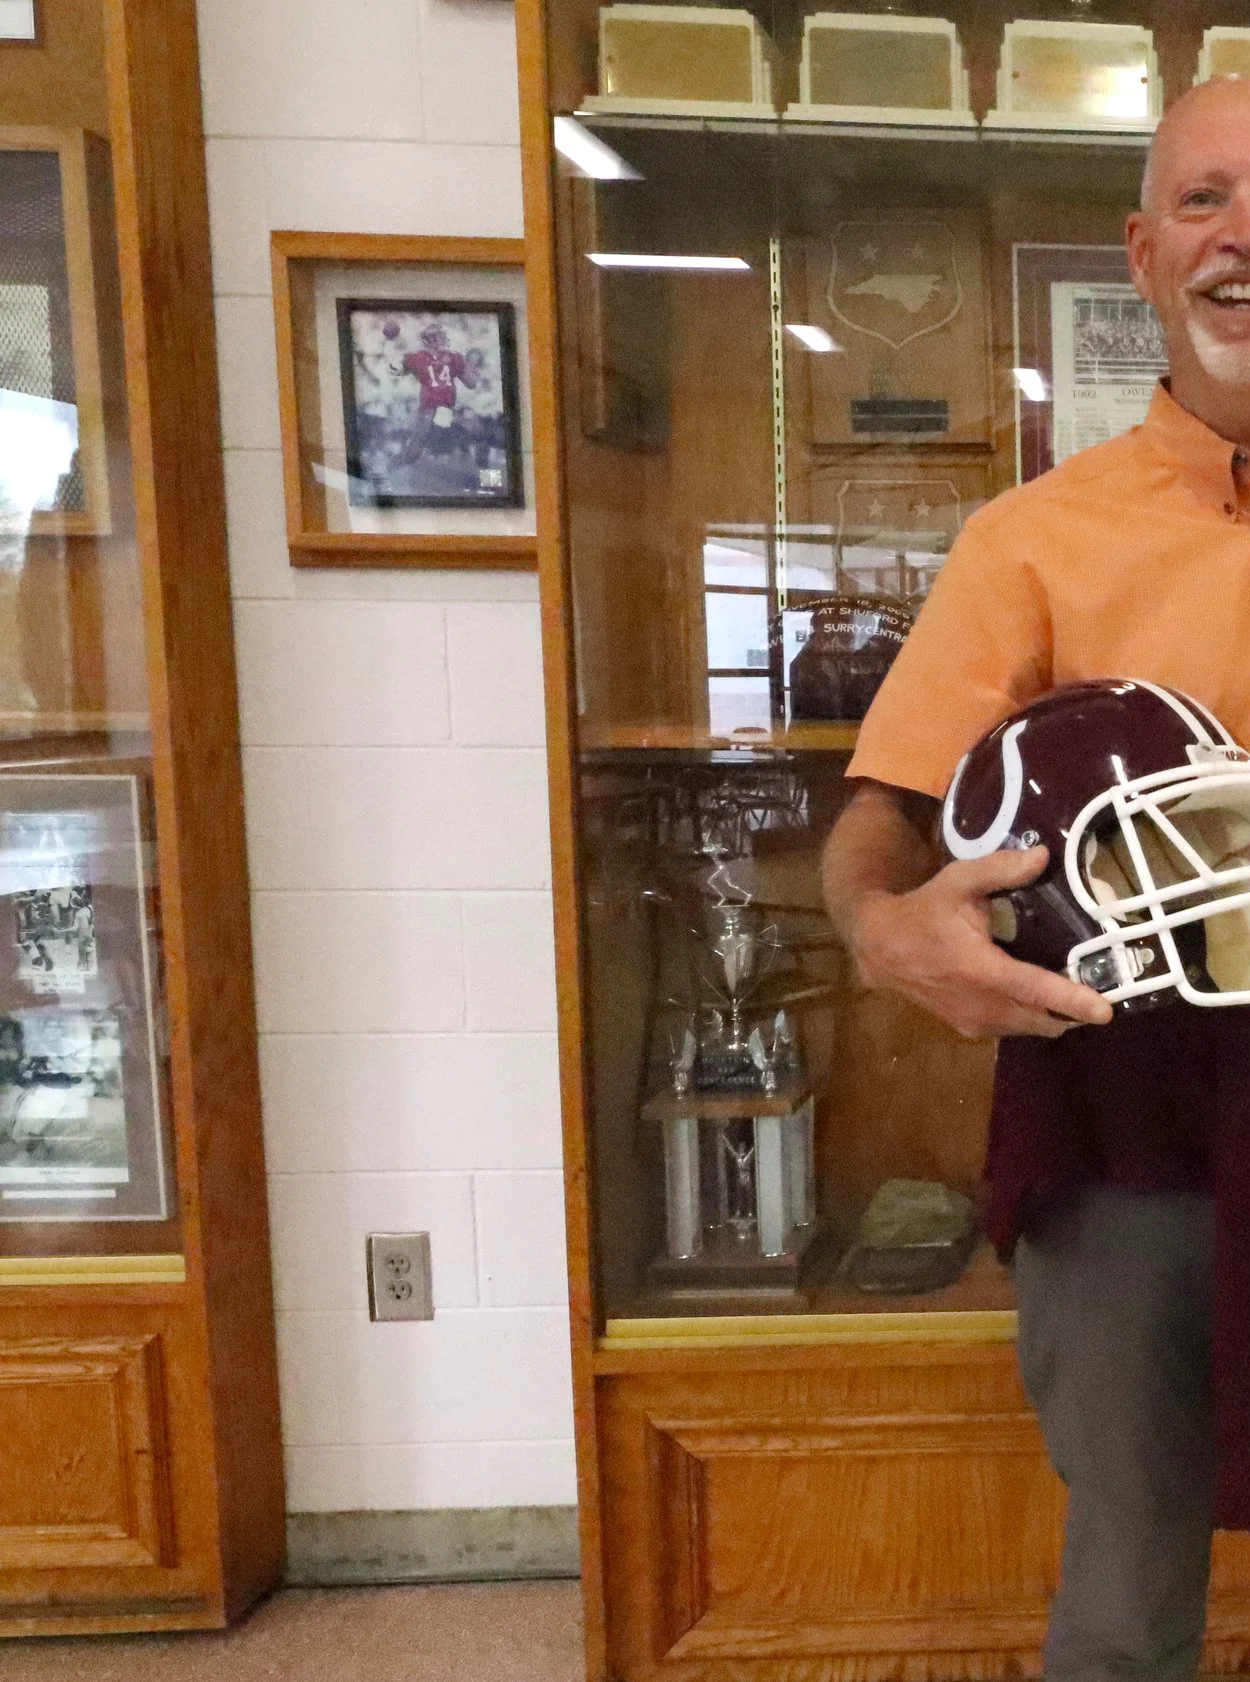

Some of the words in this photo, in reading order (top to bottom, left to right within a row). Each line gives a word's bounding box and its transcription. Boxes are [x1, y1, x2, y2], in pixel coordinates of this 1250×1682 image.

[428, 365, 452, 387] 14
[818, 607, 836, 616] AT
[839, 607, 899, 626] SHUFORD
[823, 623, 865, 634] SURRY
[864, 626, 908, 643] CENTRA
